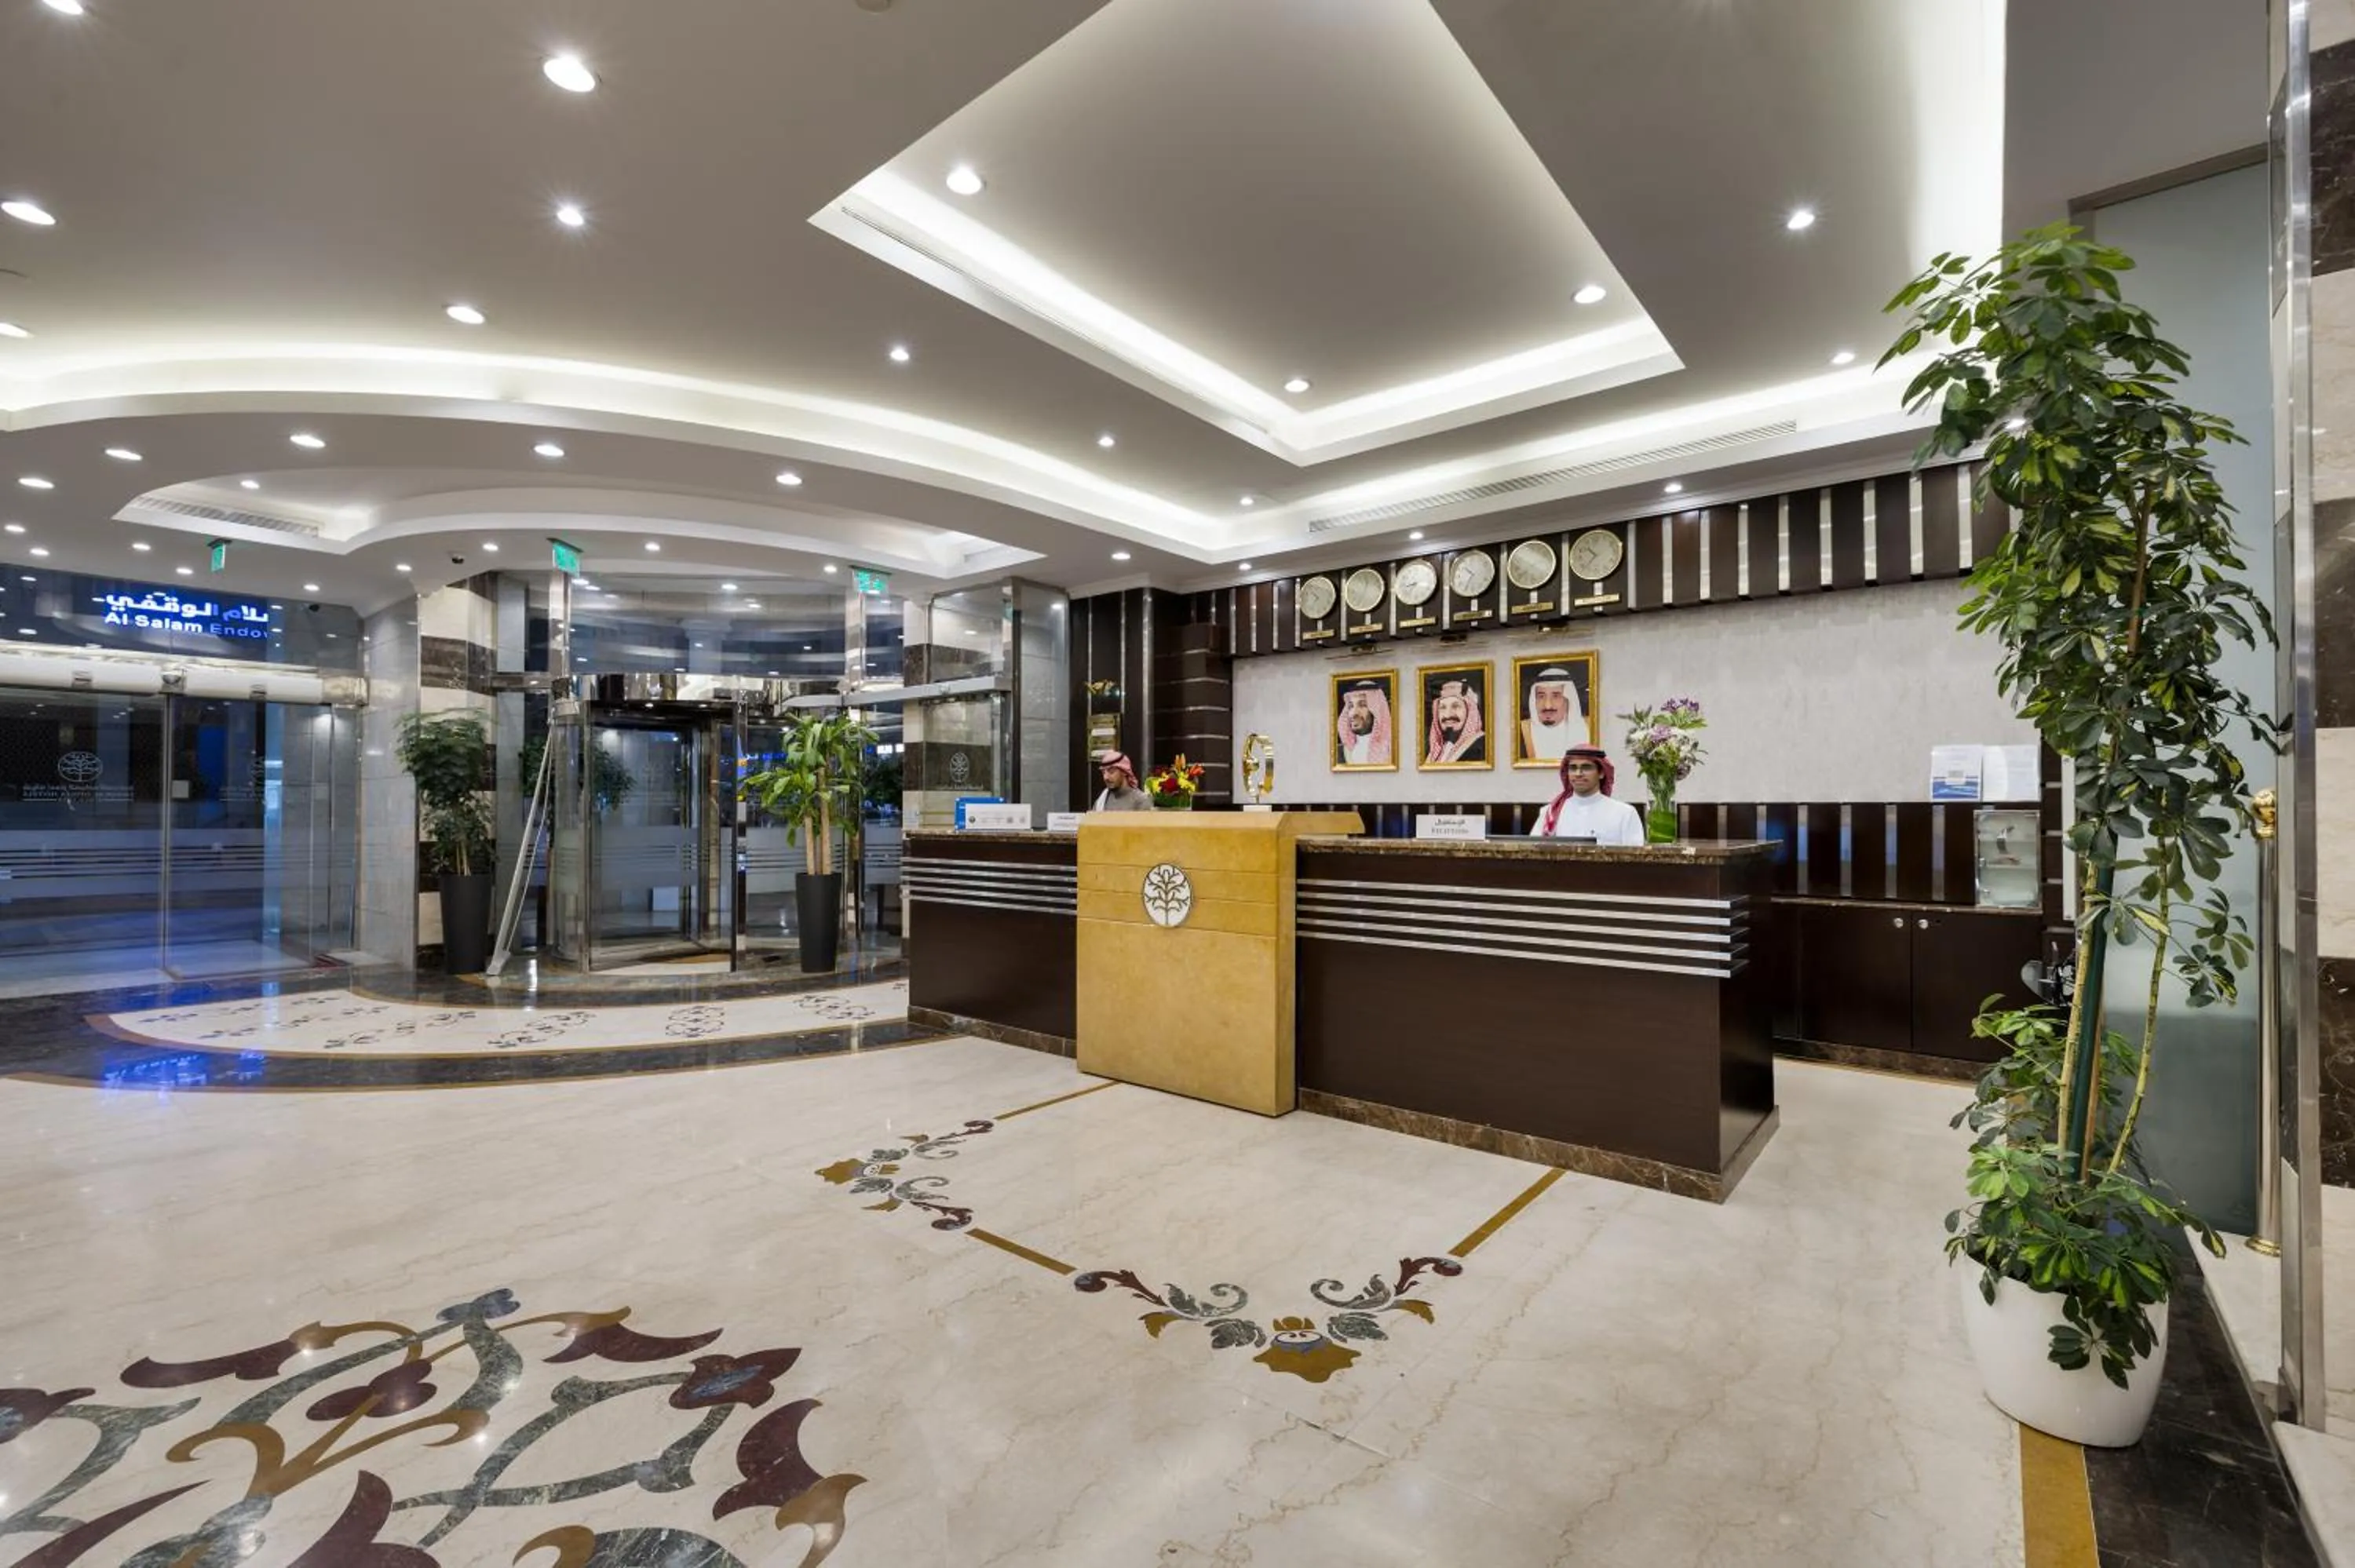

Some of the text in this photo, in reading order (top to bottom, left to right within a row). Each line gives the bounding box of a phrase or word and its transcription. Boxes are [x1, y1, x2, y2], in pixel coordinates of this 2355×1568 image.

[104, 611, 268, 638] Al Salam Endo
